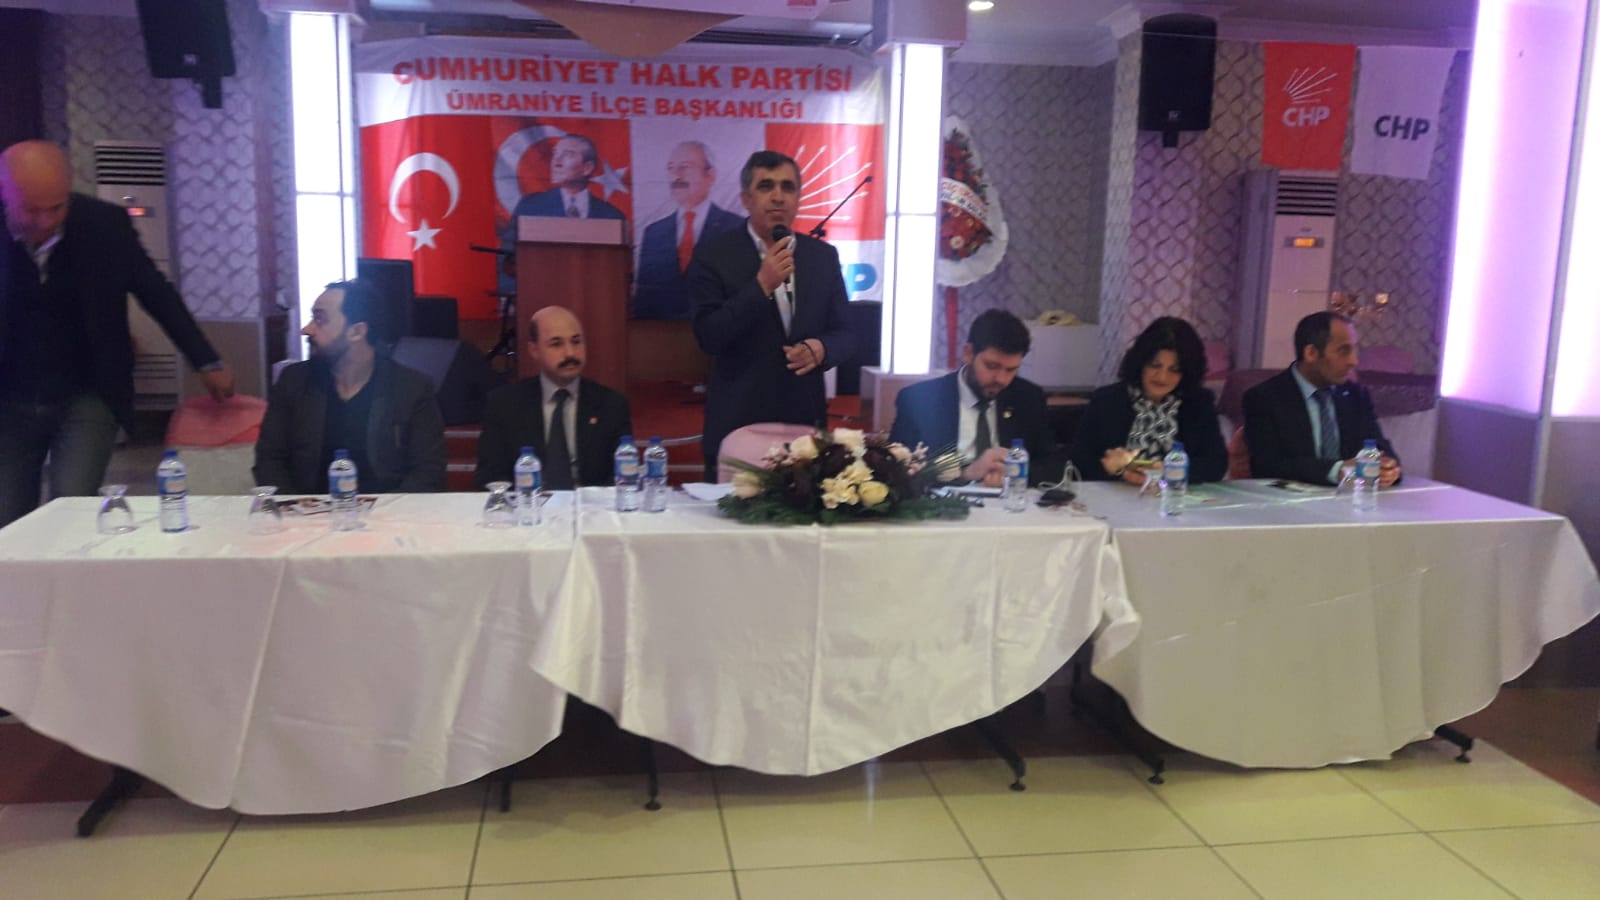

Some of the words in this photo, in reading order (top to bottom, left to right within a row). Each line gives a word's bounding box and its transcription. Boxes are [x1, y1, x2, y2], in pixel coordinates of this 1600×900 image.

[393, 55, 619, 84] CUMHURİYET
[631, 63, 721, 88] HALK
[731, 65, 852, 92] PARTİSİ
[447, 90, 582, 113] ÜMRANİYE
[592, 92, 647, 119] İLÇE
[655, 98, 803, 120] BAŞKANLIĞI
[1283, 106, 1331, 127] CHP
[1374, 115, 1430, 141] CHP
